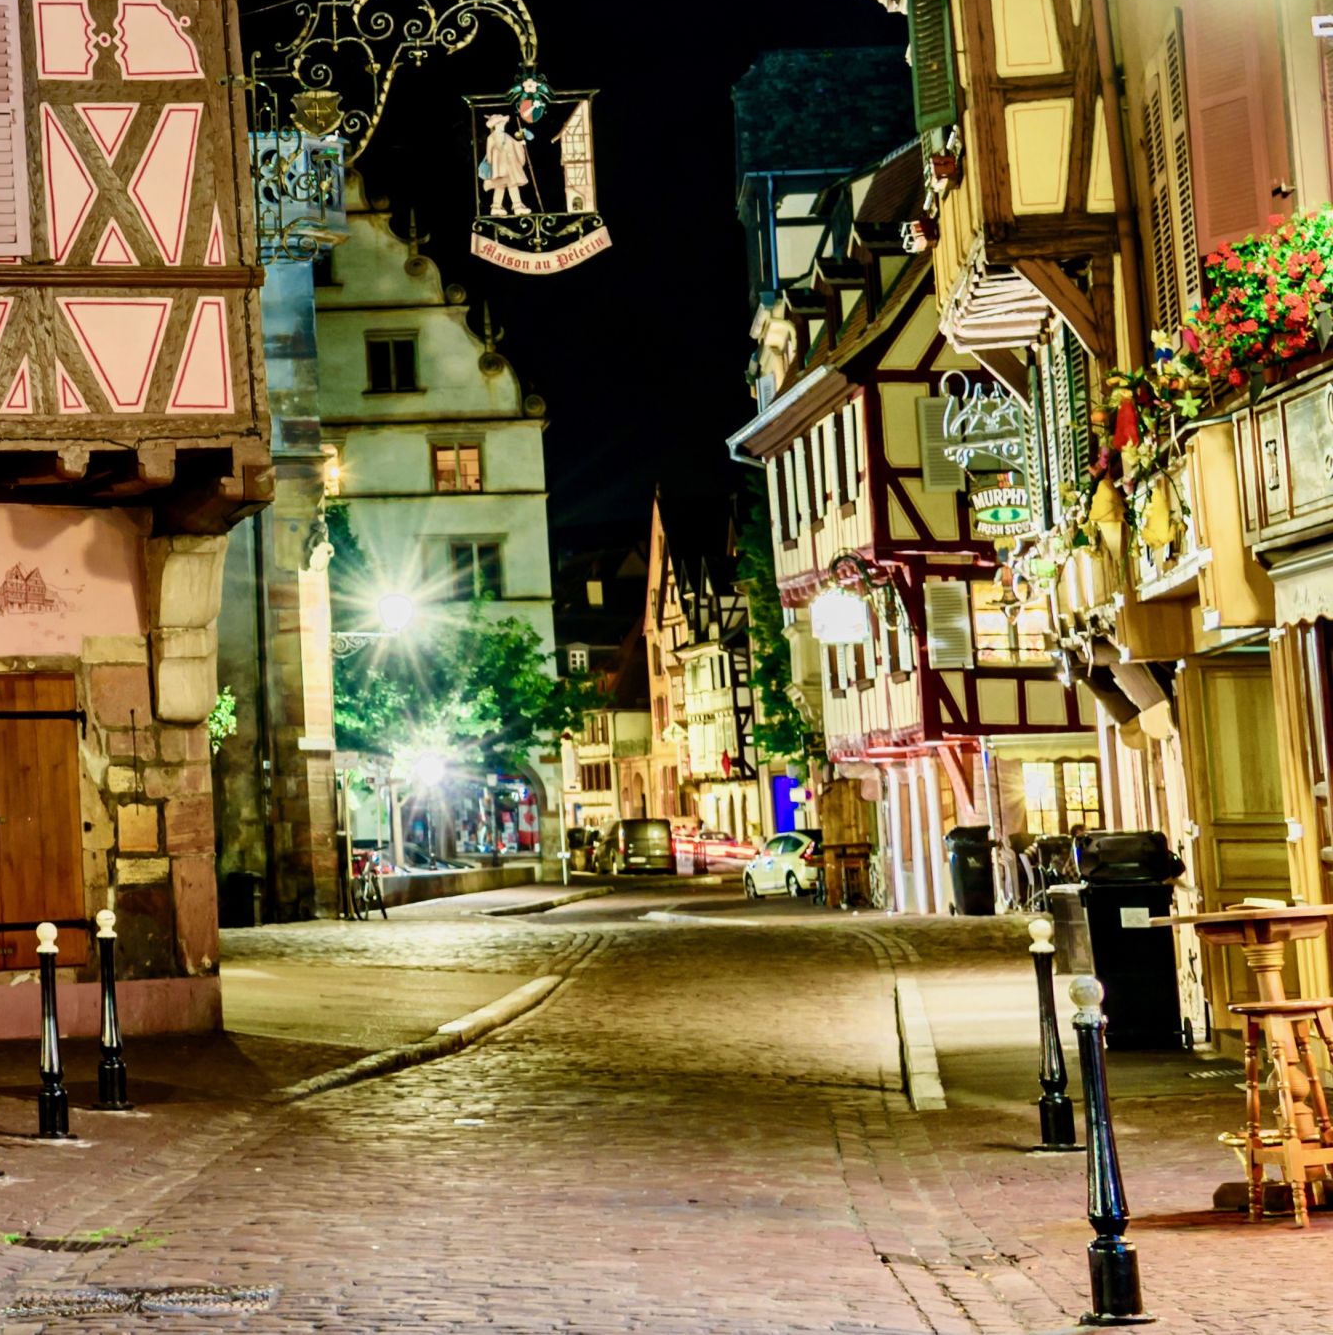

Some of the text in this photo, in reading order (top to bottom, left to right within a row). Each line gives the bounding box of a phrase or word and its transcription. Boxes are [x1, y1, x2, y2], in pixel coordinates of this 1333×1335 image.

[480, 244, 530, 270] Maison
[535, 259, 551, 270] au
[977, 522, 1033, 535] IRISH STOU
